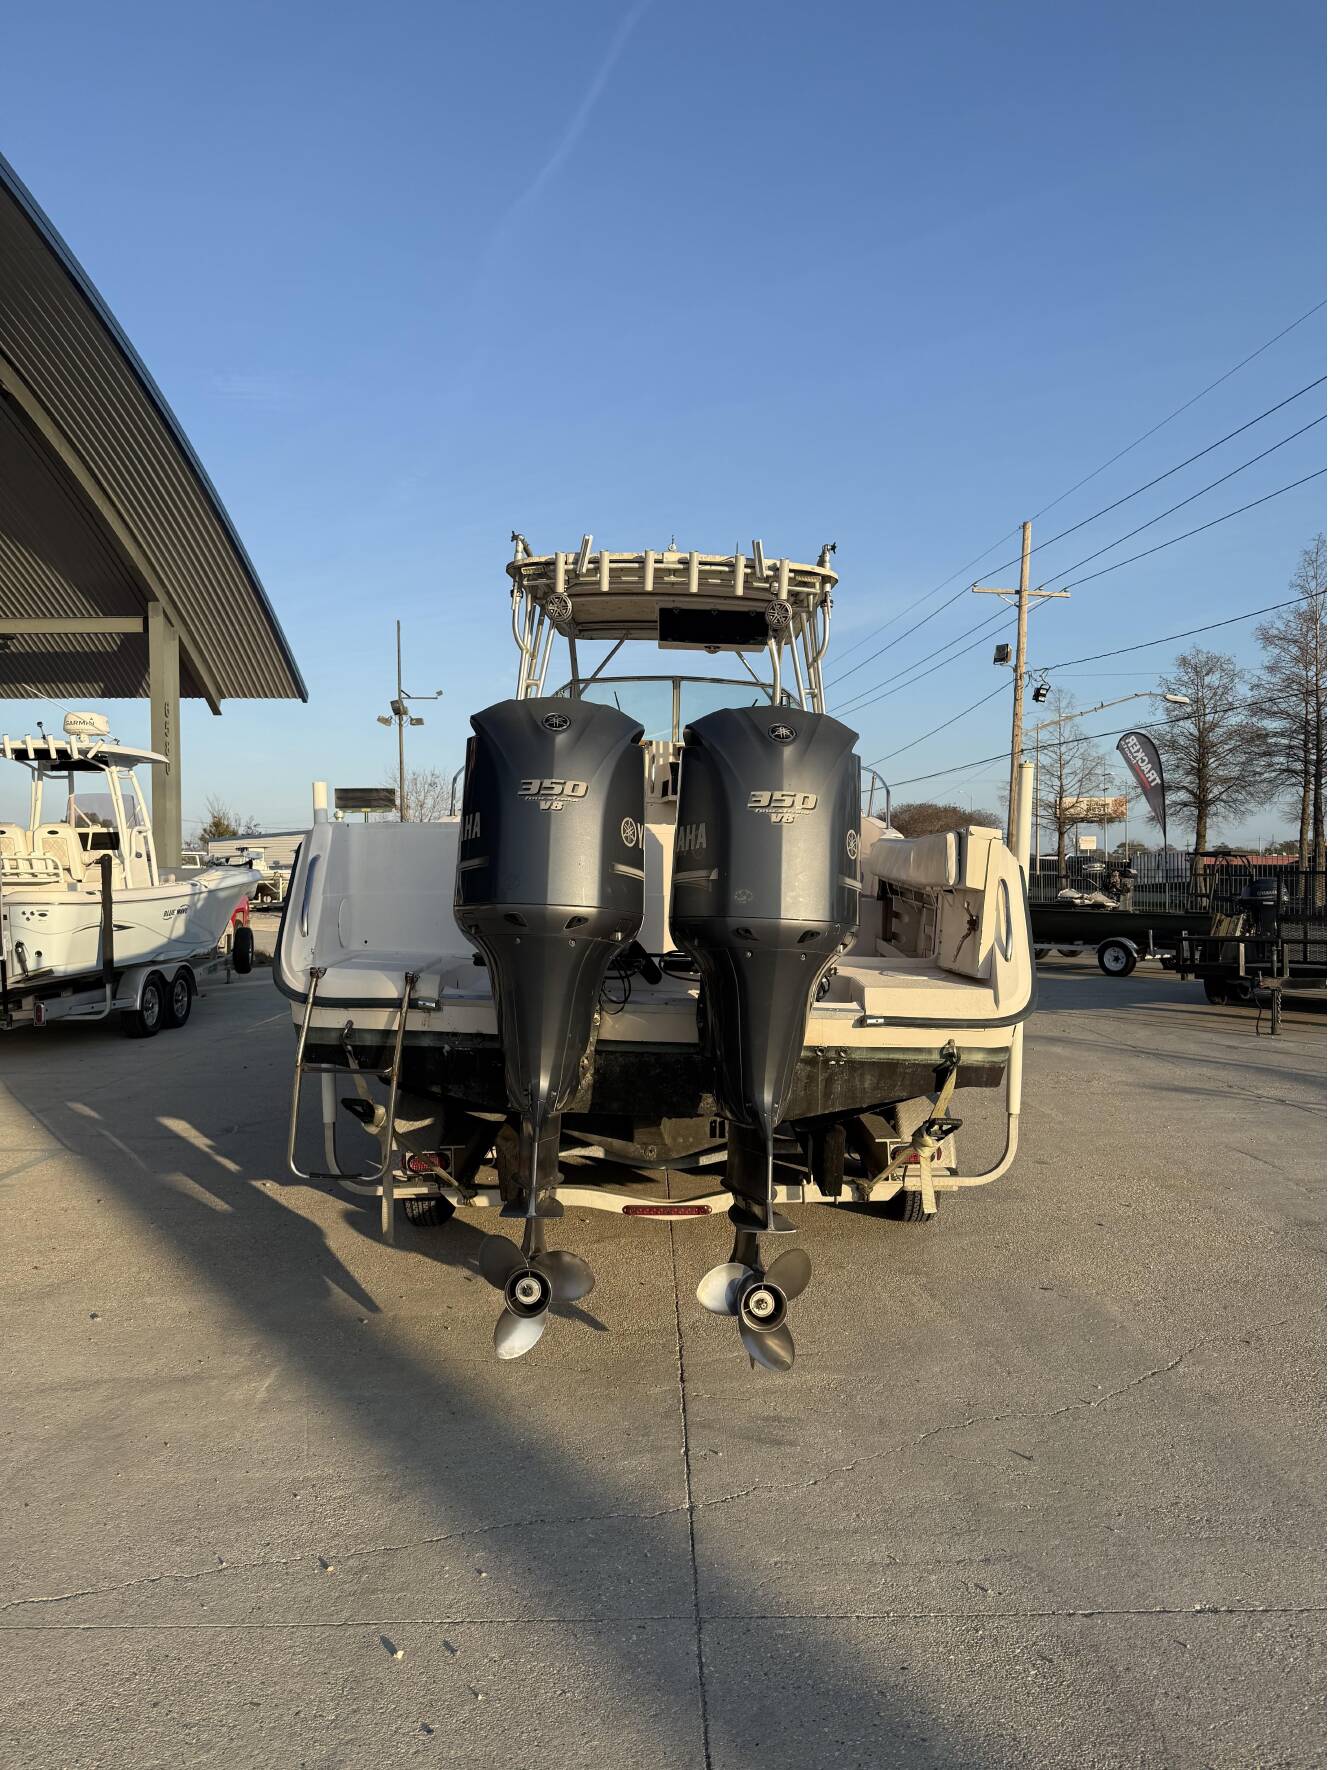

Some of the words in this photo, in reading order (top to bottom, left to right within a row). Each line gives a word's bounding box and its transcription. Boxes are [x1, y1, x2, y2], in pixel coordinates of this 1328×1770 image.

[517, 779, 588, 797] 350
[539, 800, 564, 811] V8
[747, 791, 818, 810] 350
[771, 813, 795, 824] V8
